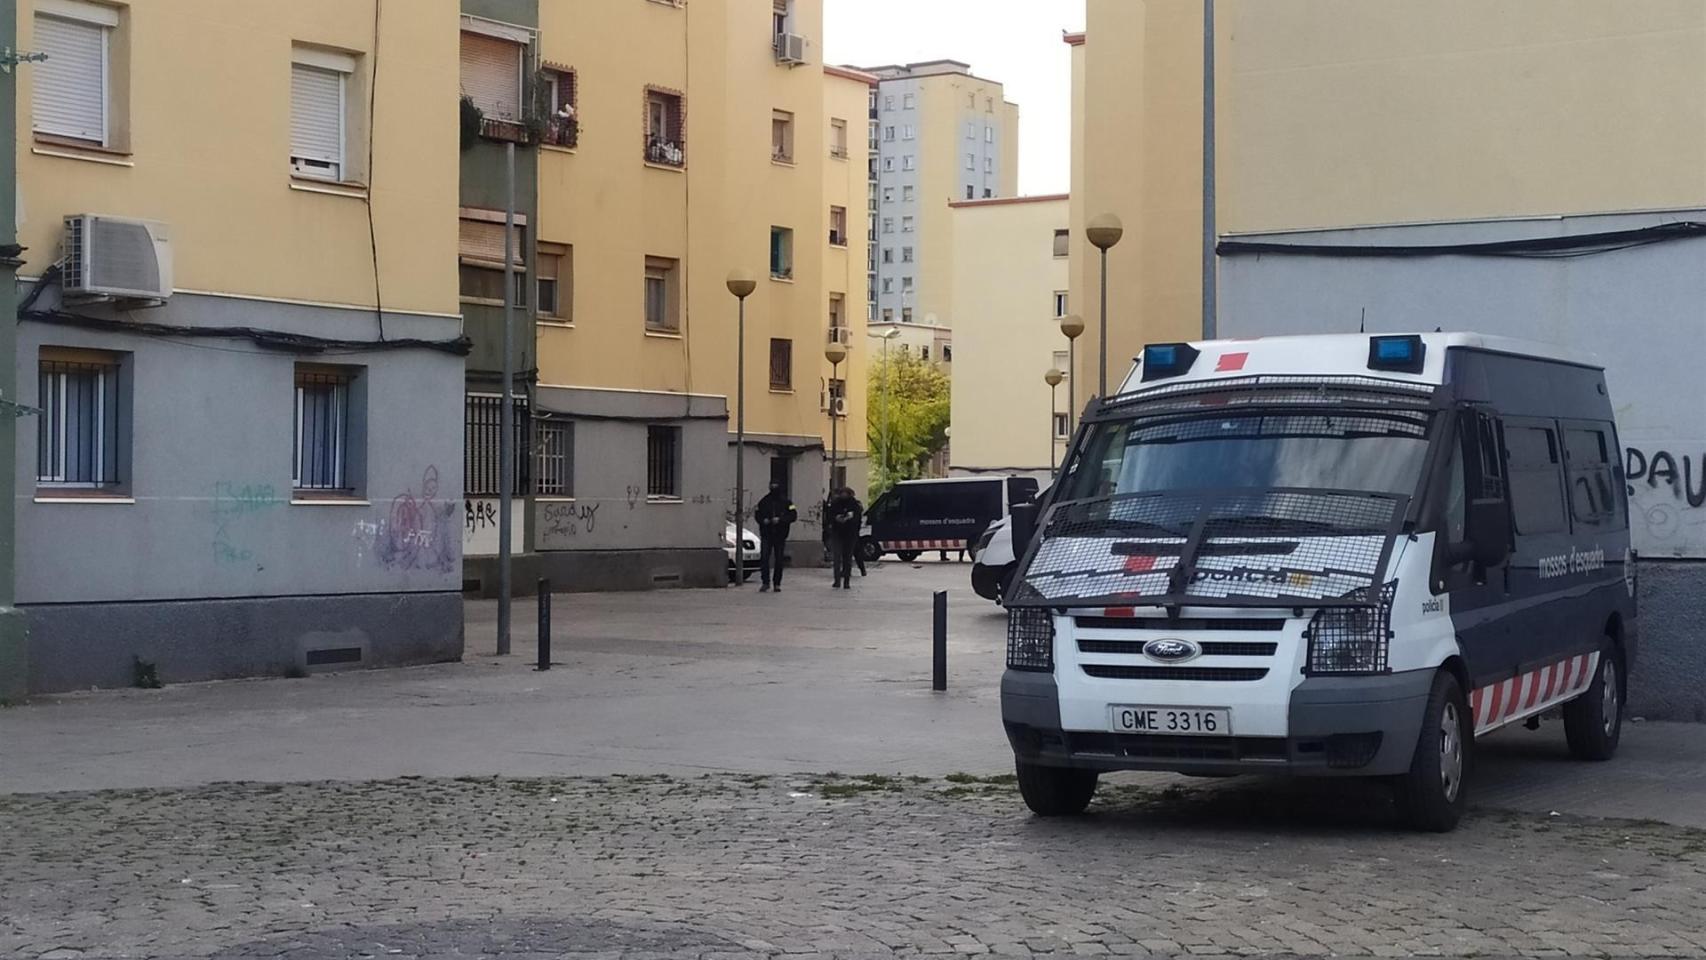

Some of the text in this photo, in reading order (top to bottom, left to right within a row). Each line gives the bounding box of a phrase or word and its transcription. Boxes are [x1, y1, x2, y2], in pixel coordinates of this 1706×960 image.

[1539, 554, 1567, 578] mossos
[1155, 641, 1183, 655] Ford
[1121, 710, 1217, 732] CME 3316
